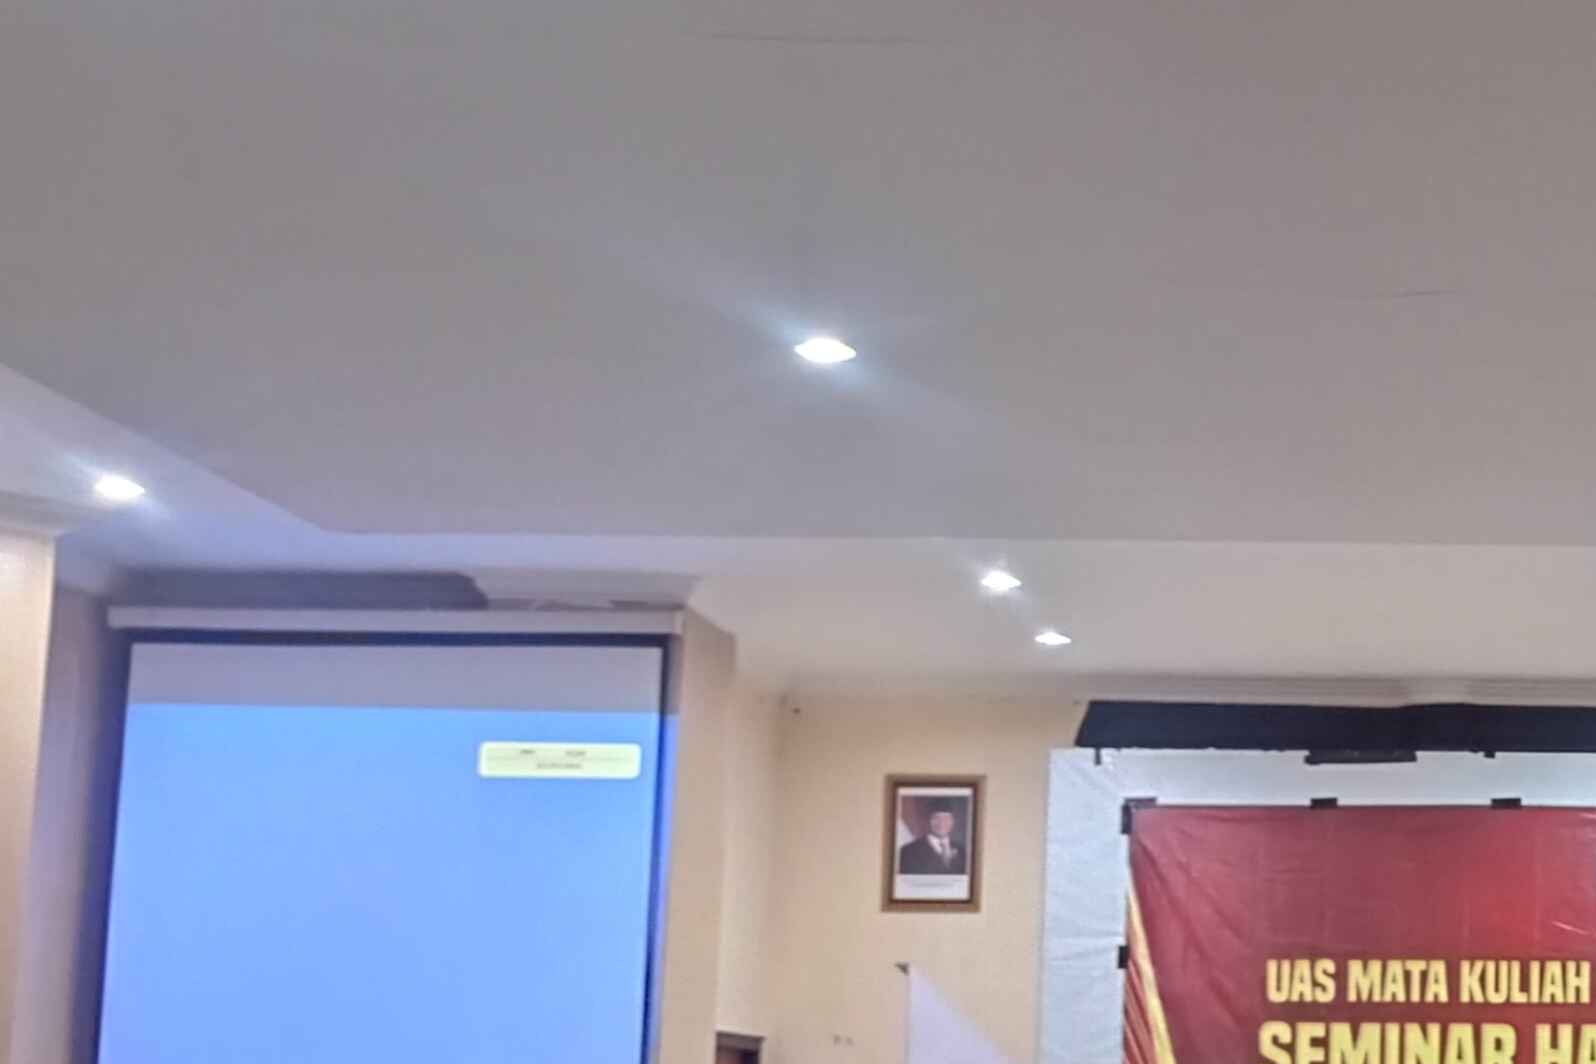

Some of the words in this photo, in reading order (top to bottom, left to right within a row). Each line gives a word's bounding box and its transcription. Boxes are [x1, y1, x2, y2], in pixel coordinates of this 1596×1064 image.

[1266, 958, 1337, 1004] UAS
[1347, 959, 1449, 1004] MATA
[1459, 959, 1591, 1004] KULIAH
